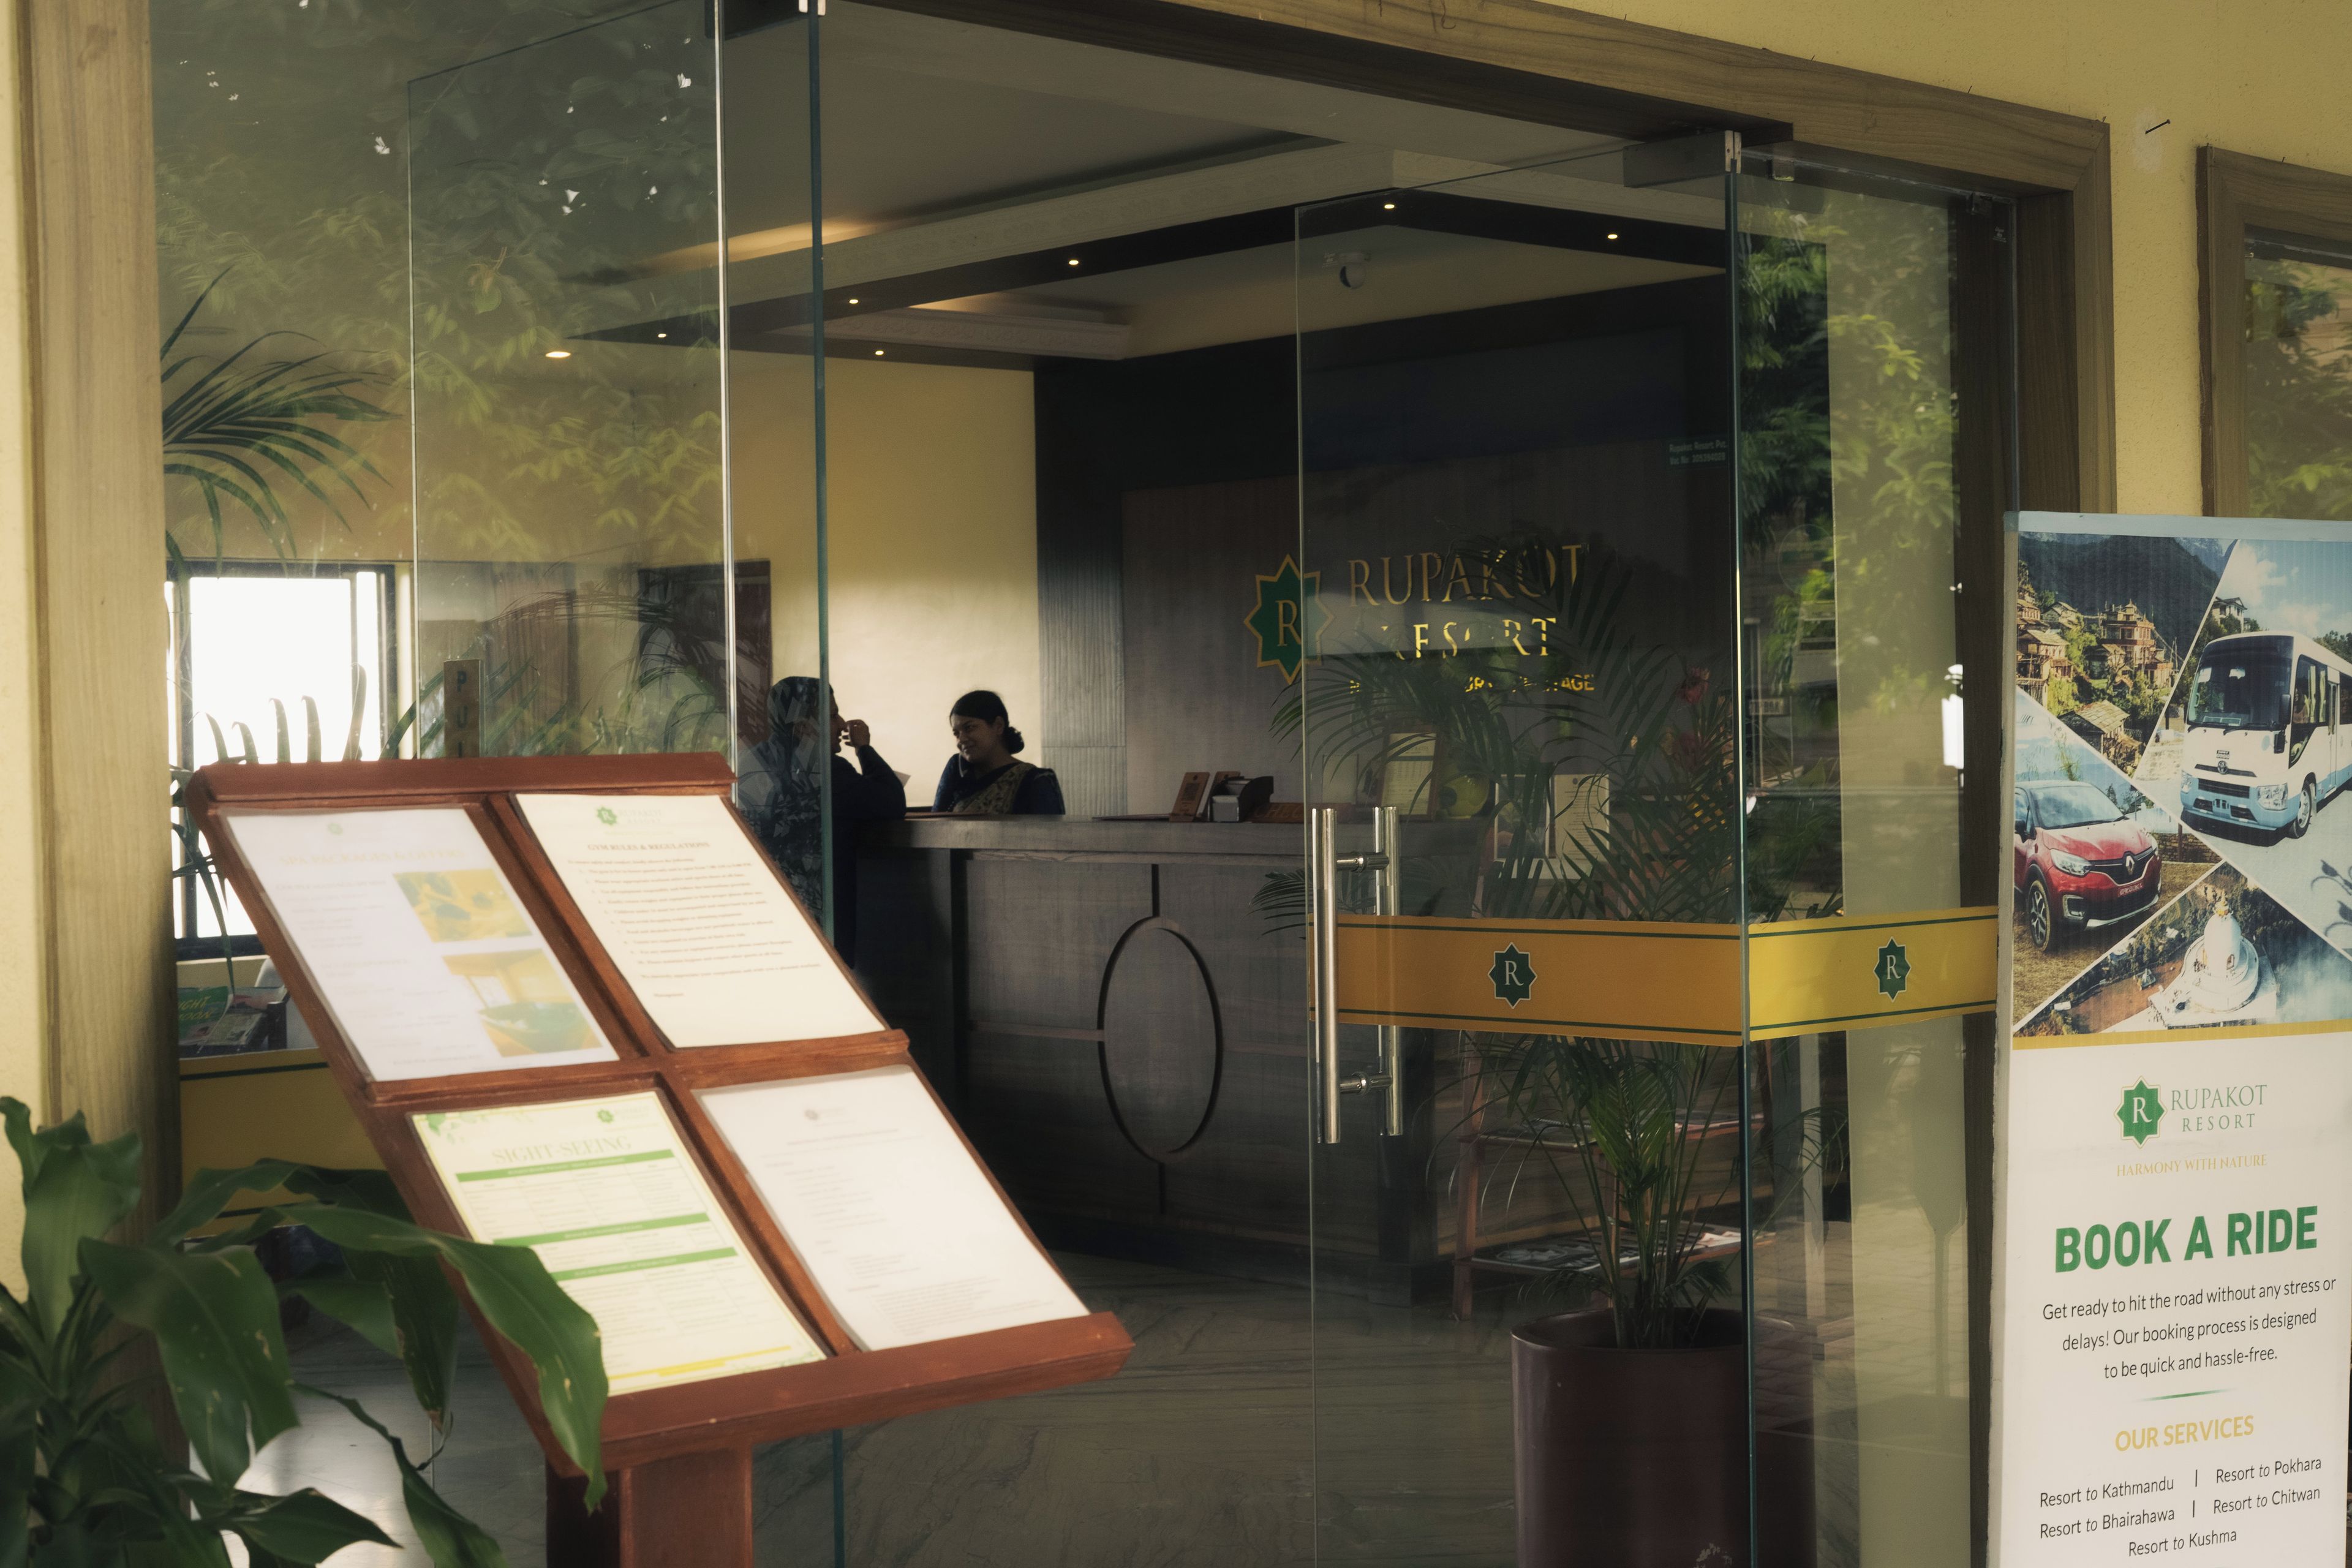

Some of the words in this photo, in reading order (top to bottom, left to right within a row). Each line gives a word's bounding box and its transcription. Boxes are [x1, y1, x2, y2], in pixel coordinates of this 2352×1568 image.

[1348, 543, 1589, 608] RUPAKOT
[1275, 599, 1302, 647] R
[1504, 960, 1525, 986] R
[1887, 955, 1902, 980] R
[2133, 1097, 2152, 1123] R
[2171, 1085, 2267, 1110] RUPAKOT
[2182, 1114, 2255, 1132] RESORT
[2117, 1161, 2181, 1176] HARMONY
[2185, 1157, 2216, 1170] WITH
[2220, 1155, 2266, 1169] NATURE
[2055, 1218, 2172, 1273] BOOK
[2184, 1216, 2214, 1261] A
[2227, 1205, 2318, 1257] RIDE
[2043, 1303, 2067, 1320] Get
[2071, 1298, 2109, 1317] ready
[2112, 1298, 2125, 1313] to
[2130, 1295, 2146, 1311] hit
[2150, 1293, 2171, 1309] the
[2174, 1289, 2203, 1306] road
[2206, 1285, 2256, 1303] without
[2259, 1285, 2281, 1300] any
[2284, 1281, 2320, 1295] stress
[2323, 1279, 2336, 1291] or
[2063, 1330, 2108, 1351] delays!
[2113, 1329, 2139, 1345] Our
[2143, 1323, 2195, 1342] booking
[2198, 1321, 2245, 1340] process
[2250, 1316, 2258, 1330] is
[2262, 1308, 2316, 1330] designed
[2105, 1364, 2117, 1379] to
[2122, 1361, 2136, 1376] be
[2141, 1356, 2175, 1378] quick
[2179, 1352, 2201, 1370] and
[2206, 1347, 2277, 1367] hassle-free.
[2115, 1427, 2158, 1452] OUR
[2163, 1415, 2253, 1446] SERVICES
[2217, 1466, 2255, 1483] Resort
[2259, 1464, 2270, 1477] to
[2275, 1458, 2321, 1475] Pokhara
[2040, 1489, 2081, 1507] Resort
[2086, 1487, 2097, 1501] to
[2103, 1476, 2174, 1499] Kathmandu
[2214, 1496, 2252, 1514] Resort
[2256, 1494, 2267, 1507] to
[2272, 1489, 2320, 1505] Chitwan
[2040, 1520, 2081, 1539] Resort
[2086, 1518, 2097, 1532] to
[2103, 1509, 2174, 1529] Bhairahawa
[2129, 1538, 2168, 1556] Resort
[2173, 1537, 2184, 1550] to
[2189, 1530, 2236, 1548] Kushma
